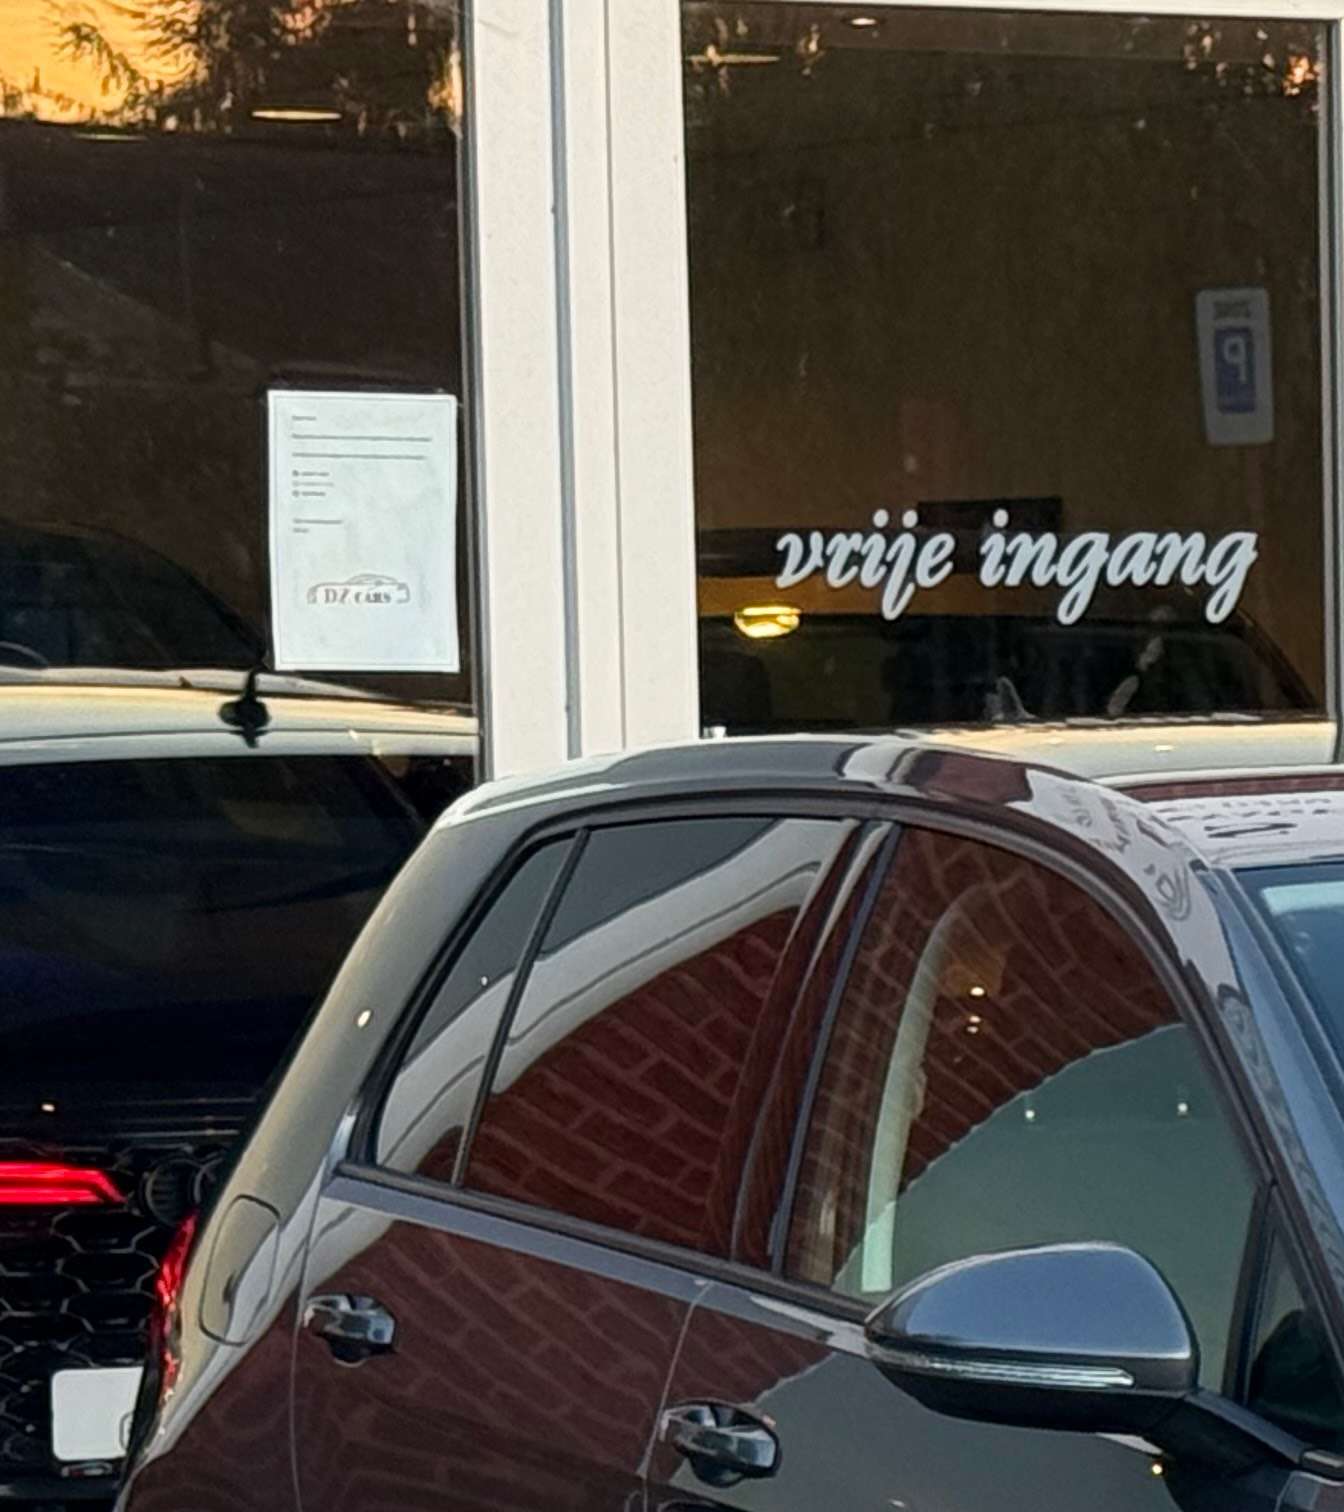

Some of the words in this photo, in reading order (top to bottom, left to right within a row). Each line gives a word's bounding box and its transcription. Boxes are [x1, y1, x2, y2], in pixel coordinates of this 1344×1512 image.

[324, 588, 350, 604] DZ
[776, 509, 956, 621] vrije
[980, 508, 1259, 624] ingang
